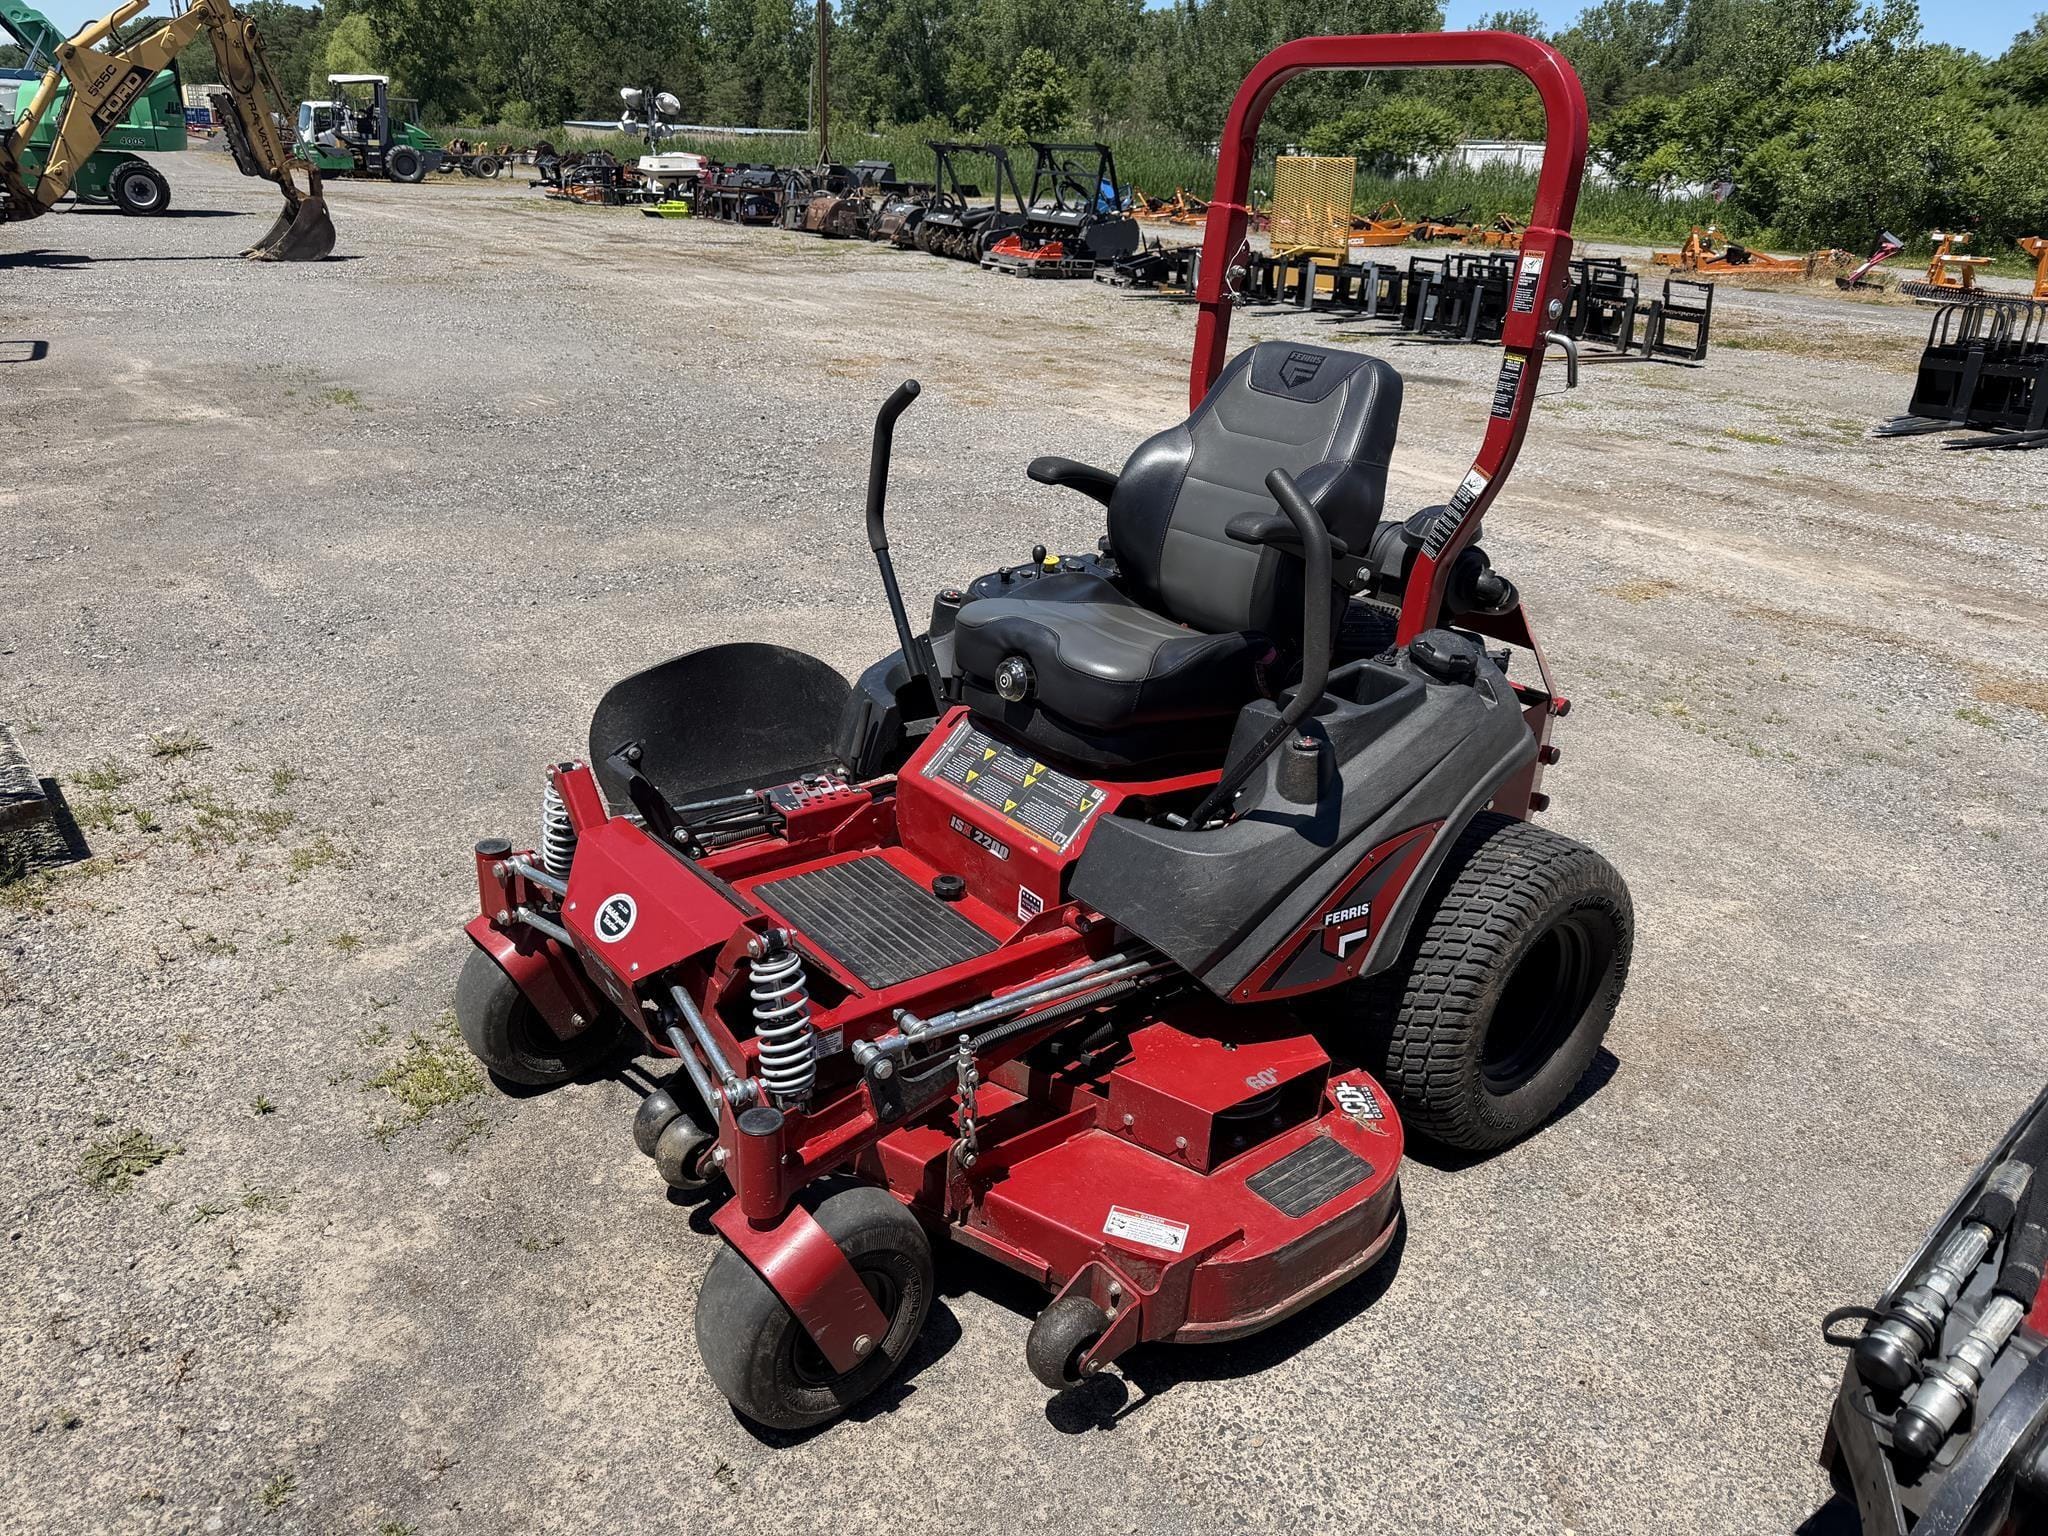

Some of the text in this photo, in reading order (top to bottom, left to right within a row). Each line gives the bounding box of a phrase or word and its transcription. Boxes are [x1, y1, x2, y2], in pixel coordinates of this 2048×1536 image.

[88, 64, 117, 97] 555C
[97, 72, 142, 124] FORD
[120, 136, 145, 146] 400S
[1289, 351, 1323, 364] FERRIS
[1325, 903, 1369, 926] FERRIS
